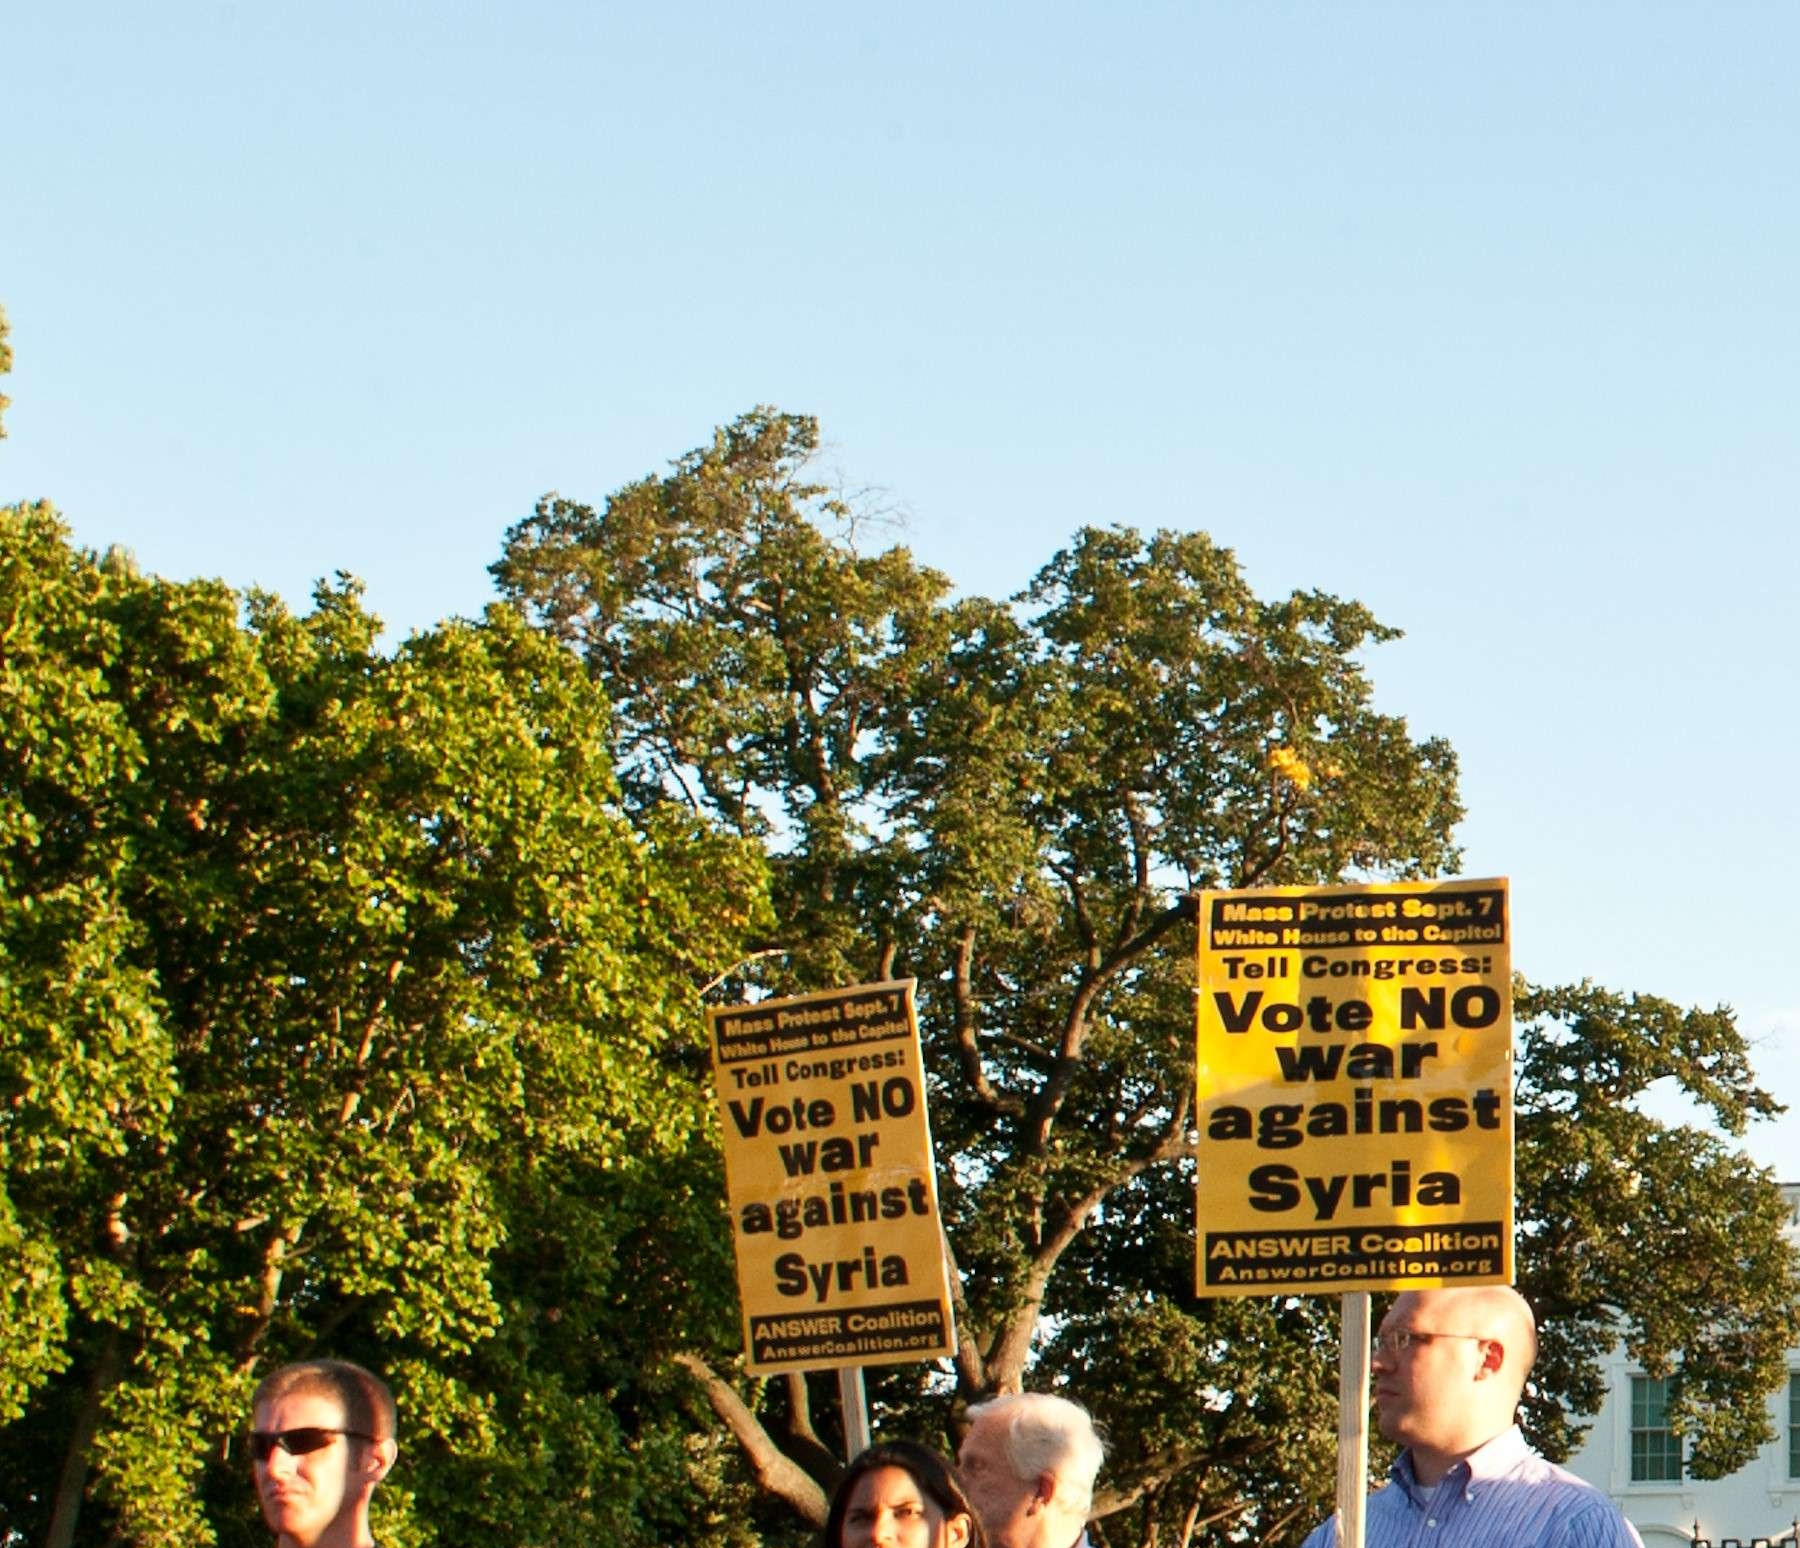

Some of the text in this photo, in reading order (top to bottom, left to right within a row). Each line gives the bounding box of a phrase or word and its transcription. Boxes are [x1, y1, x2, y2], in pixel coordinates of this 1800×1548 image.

[1223, 898, 1493, 922] Mass Protest Sept. 7
[1213, 923, 1501, 945] White House to the Capitol
[1222, 955, 1492, 981] Tell Congress:
[725, 995, 898, 1037] Mass Protest Sept. 7
[1214, 985, 1500, 1034] Vote NO
[720, 1021, 908, 1059] White House to the Capitol
[731, 1050, 904, 1088] Tell Congress:
[1276, 1041, 1438, 1083] war
[727, 1077, 914, 1138] Vote NO
[1208, 1088, 1500, 1149] against
[779, 1132, 879, 1177] war
[741, 1178, 929, 1239] against
[1248, 1160, 1460, 1220] Syria
[1210, 1230, 1499, 1259] ANSWER Coalition
[775, 1246, 908, 1301] Syria
[1219, 1258, 1492, 1282] AnswerCoalition.org
[755, 1309, 940, 1340] ANSWER Coalition
[763, 1333, 938, 1359] AnswerCoalition.org
